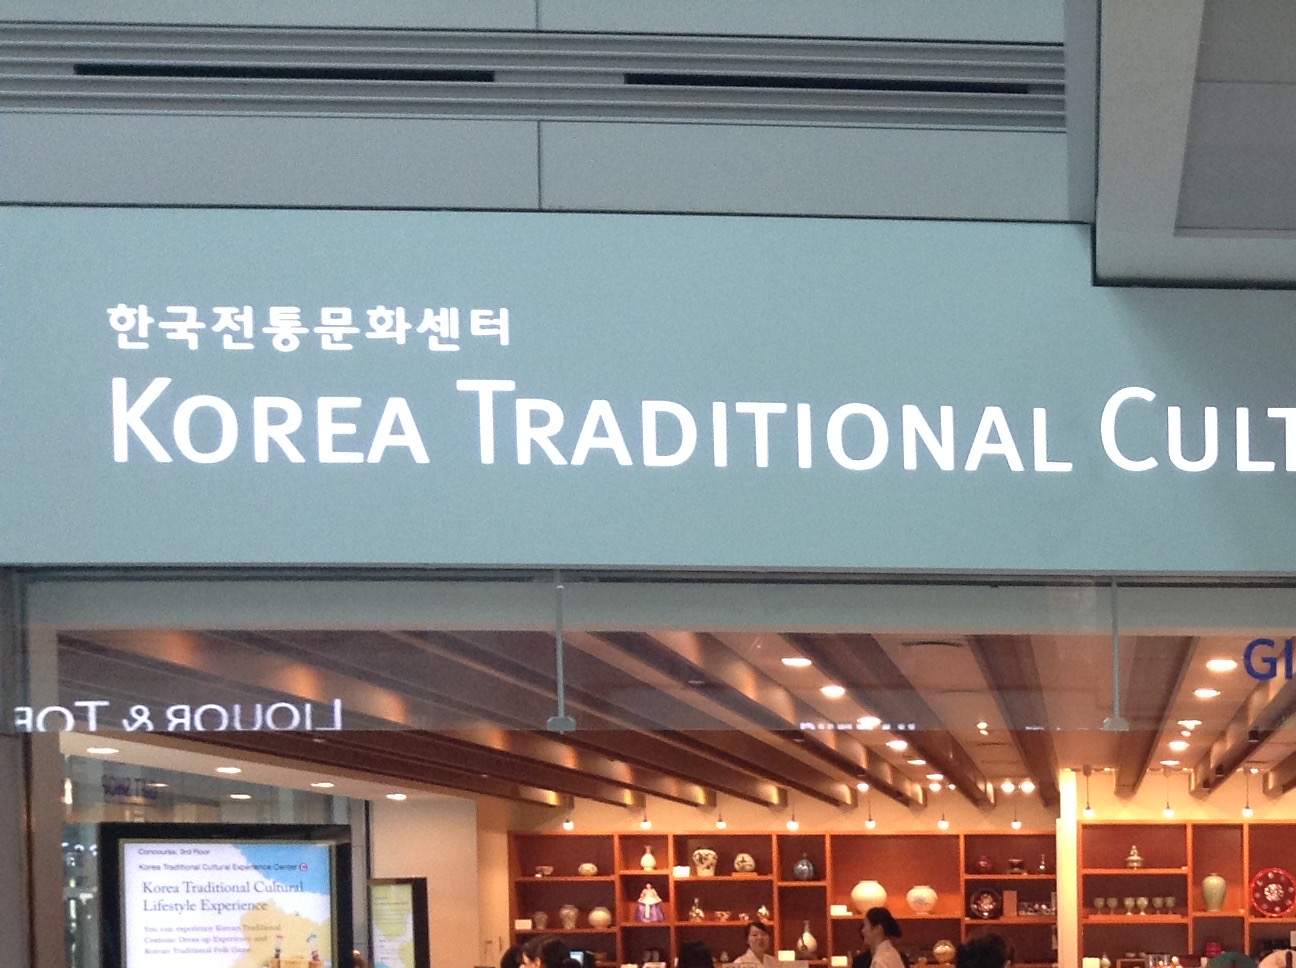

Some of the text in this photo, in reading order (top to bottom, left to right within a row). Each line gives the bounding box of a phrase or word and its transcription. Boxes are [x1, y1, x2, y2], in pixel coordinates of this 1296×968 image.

[107, 304, 510, 352] 한국전통문화센터
[112, 377, 430, 464] KOREA
[456, 380, 1072, 471] TRADITIONAL
[143, 880, 304, 894] Korea Traditional Cultural
[143, 899, 267, 914] Lifestyle Experience
